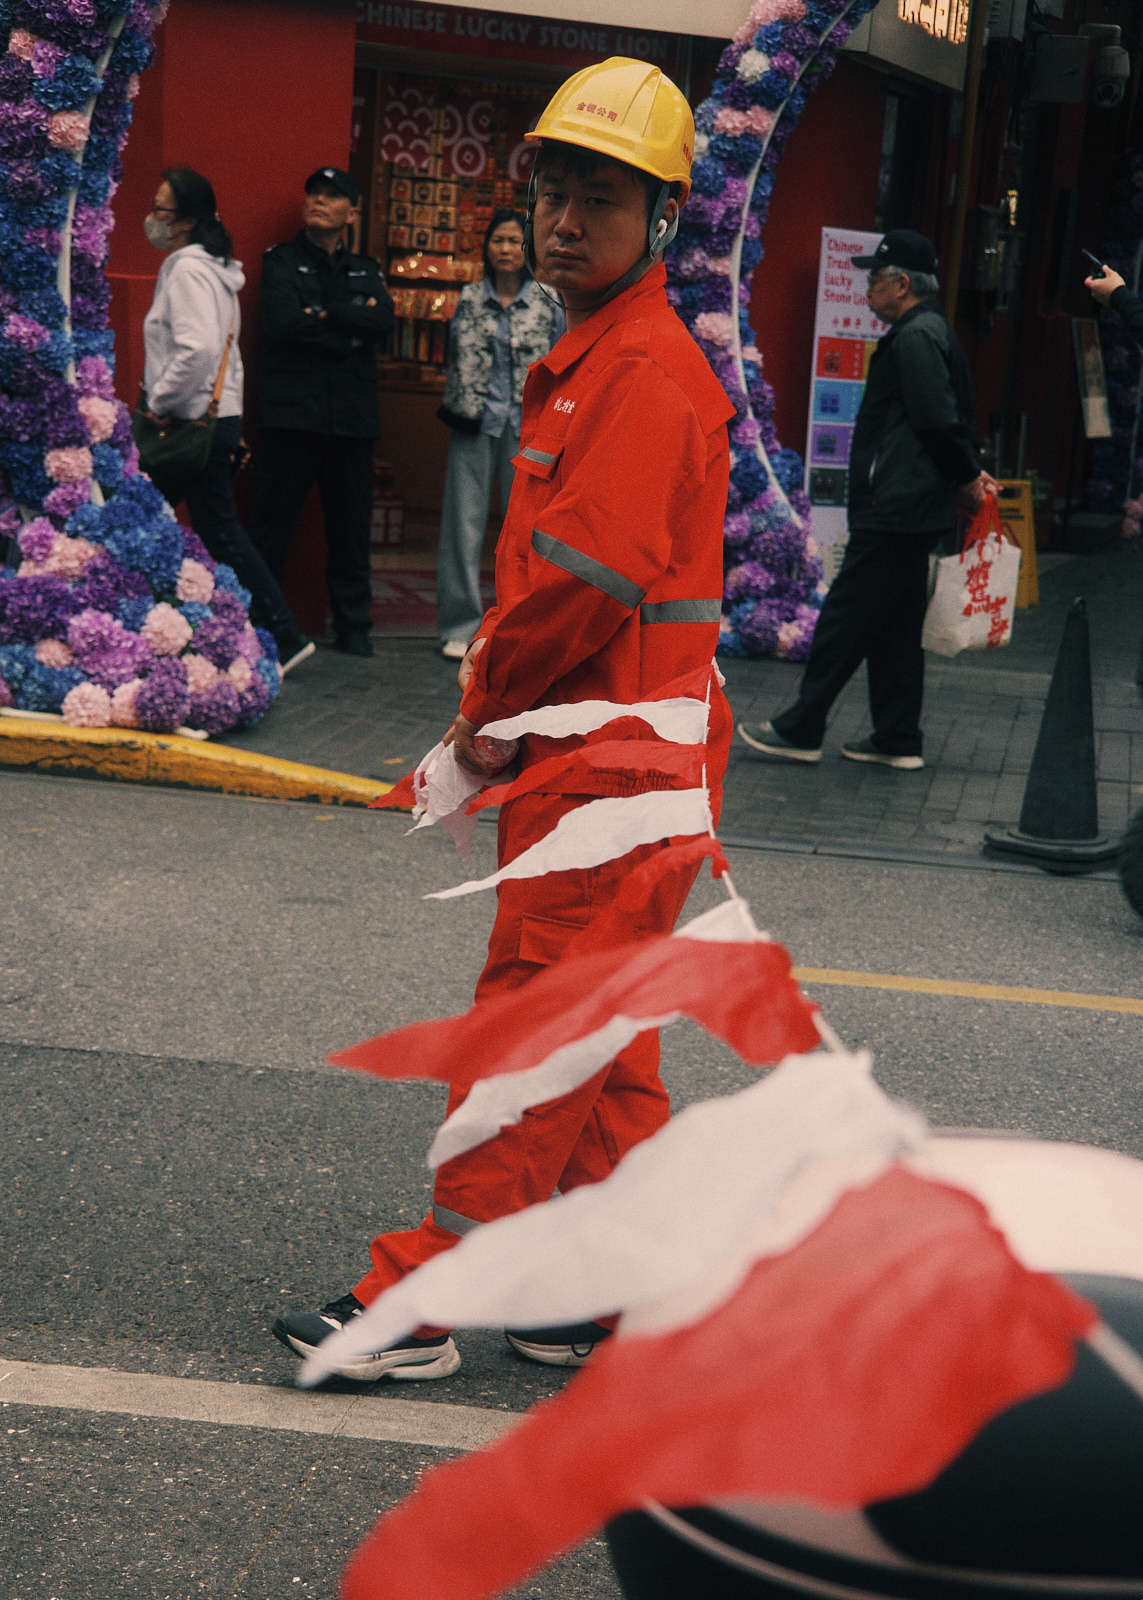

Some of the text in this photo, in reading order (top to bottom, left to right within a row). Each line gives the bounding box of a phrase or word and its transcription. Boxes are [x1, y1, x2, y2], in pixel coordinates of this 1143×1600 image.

[355, 3, 667, 58] CHINESE LUCKY STONE LION
[827, 239, 864, 254] Chinese
[825, 272, 854, 291] Lucky
